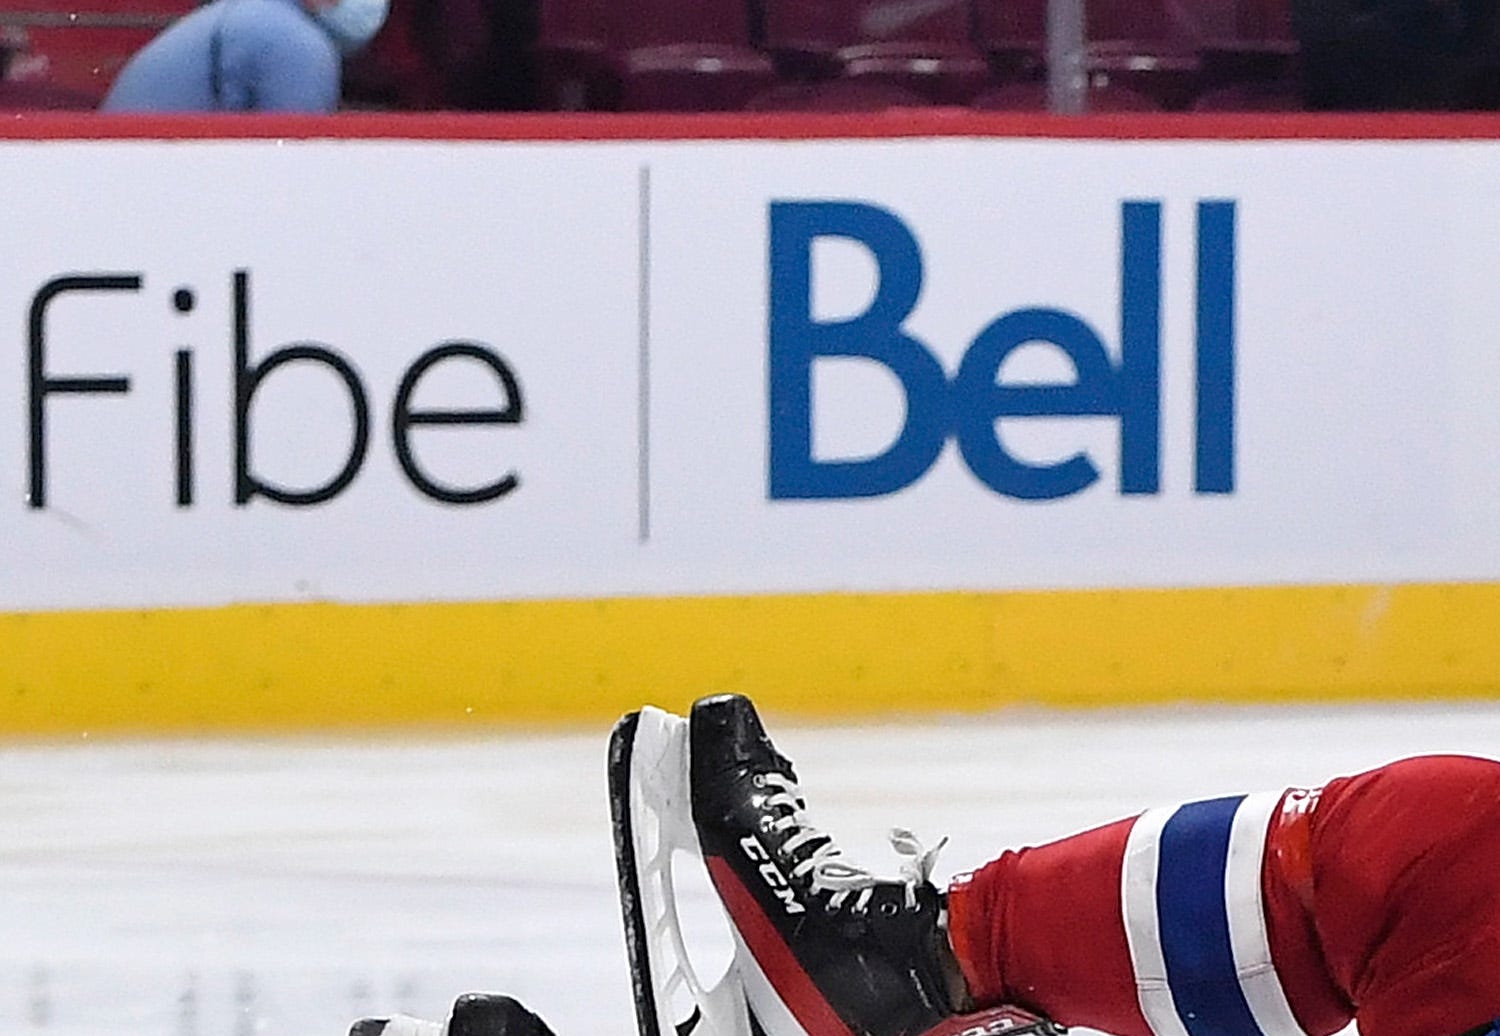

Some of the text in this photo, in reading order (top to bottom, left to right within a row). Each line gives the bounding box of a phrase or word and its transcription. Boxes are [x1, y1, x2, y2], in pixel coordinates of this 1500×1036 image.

[27, 270, 525, 508] Fibe
[767, 198, 1238, 501] Bell
[739, 833, 806, 914] CCM
